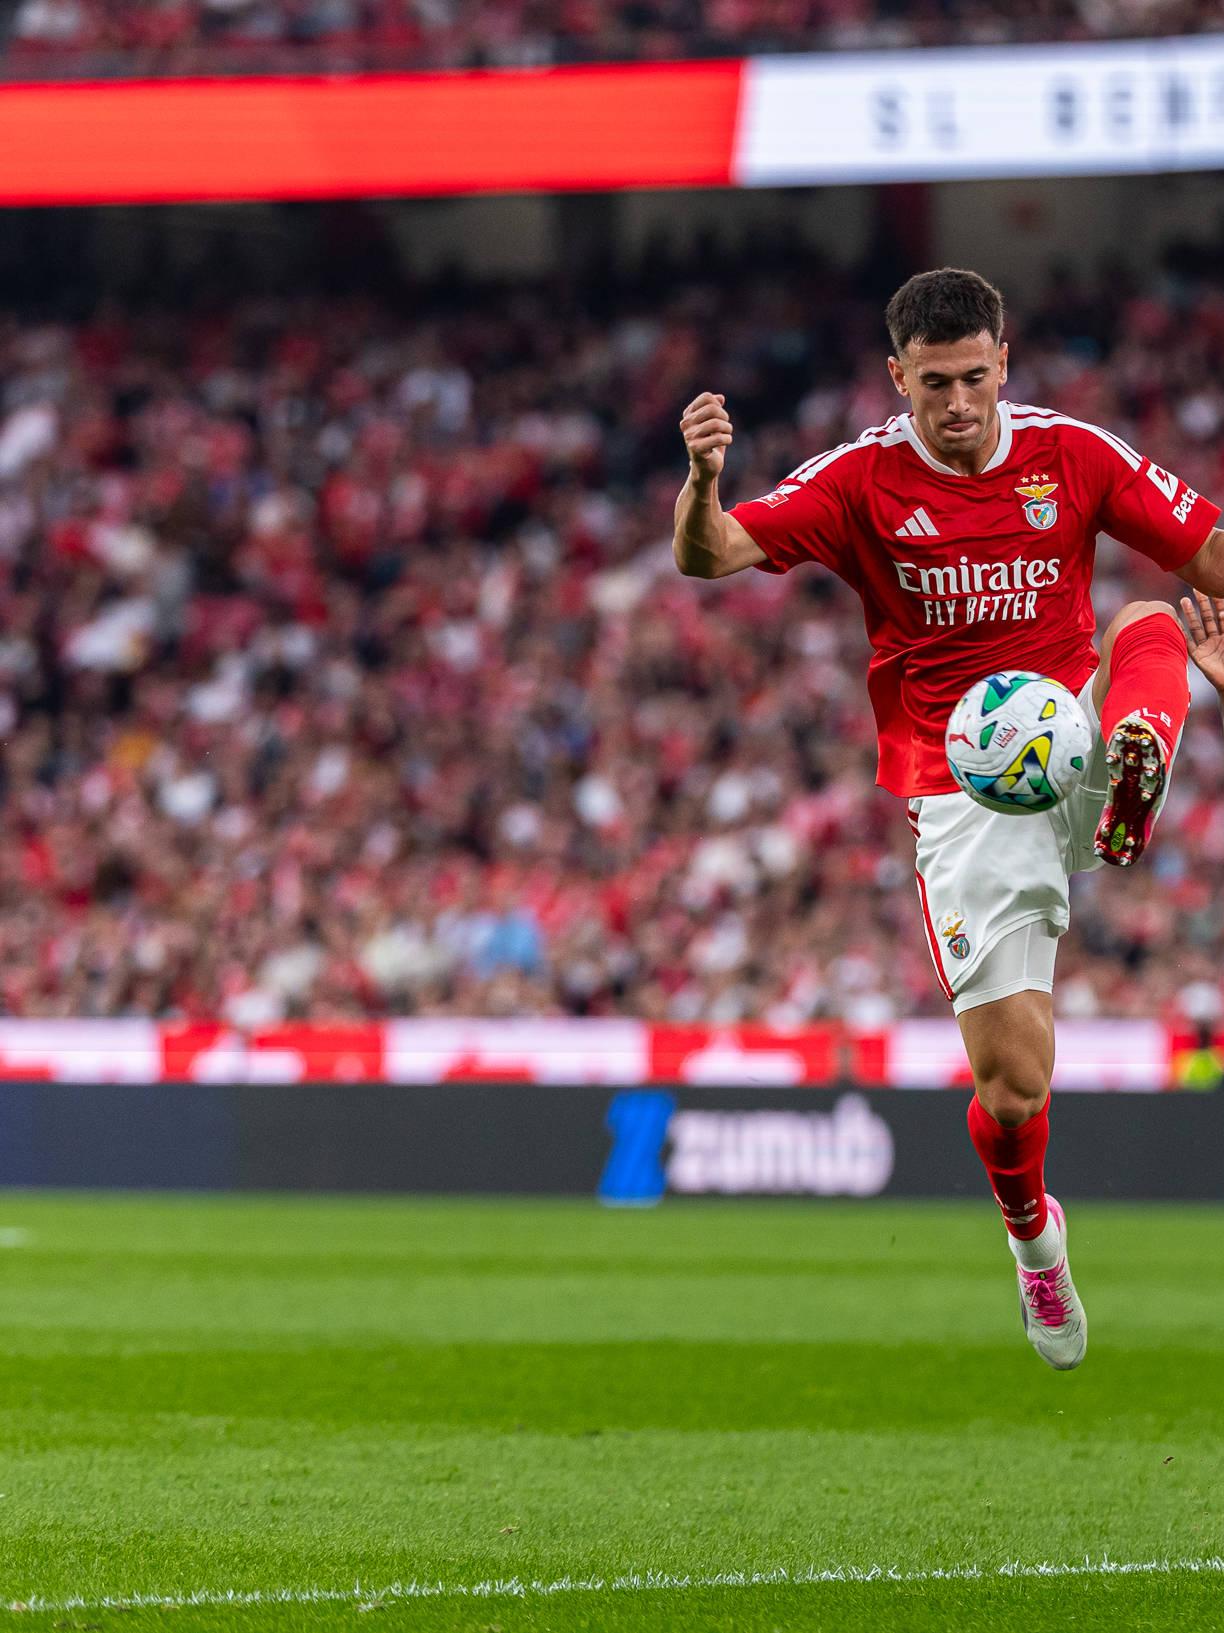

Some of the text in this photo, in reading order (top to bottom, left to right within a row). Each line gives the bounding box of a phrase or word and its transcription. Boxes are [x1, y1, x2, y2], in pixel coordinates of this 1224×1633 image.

[893, 556, 1061, 596] Emirates
[924, 590, 1038, 626] FLY BETTER
[667, 1093, 895, 1196] zumub
